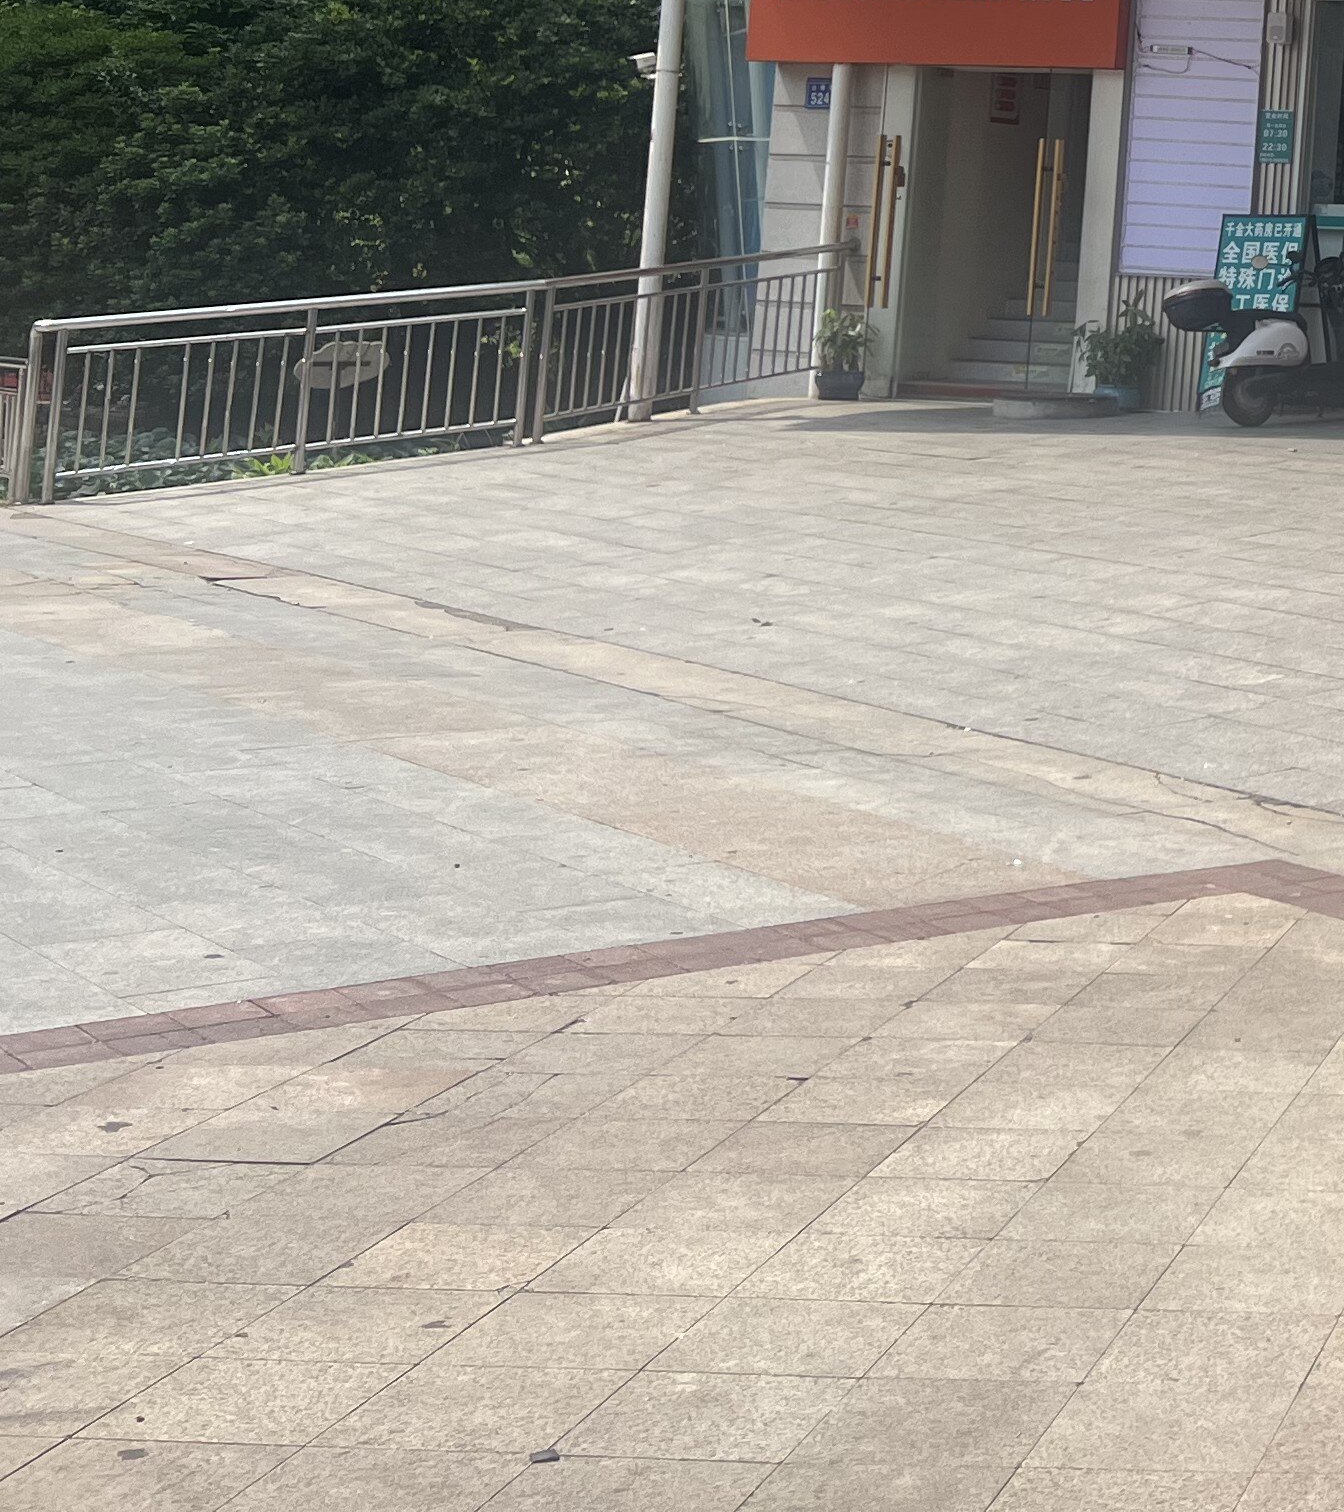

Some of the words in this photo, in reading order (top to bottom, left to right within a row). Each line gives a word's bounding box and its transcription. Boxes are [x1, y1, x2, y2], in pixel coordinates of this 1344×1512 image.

[811, 92, 830, 105] 524
[1262, 143, 1287, 151] 22:30
[1225, 222, 1302, 238] 千金大药房已开通
